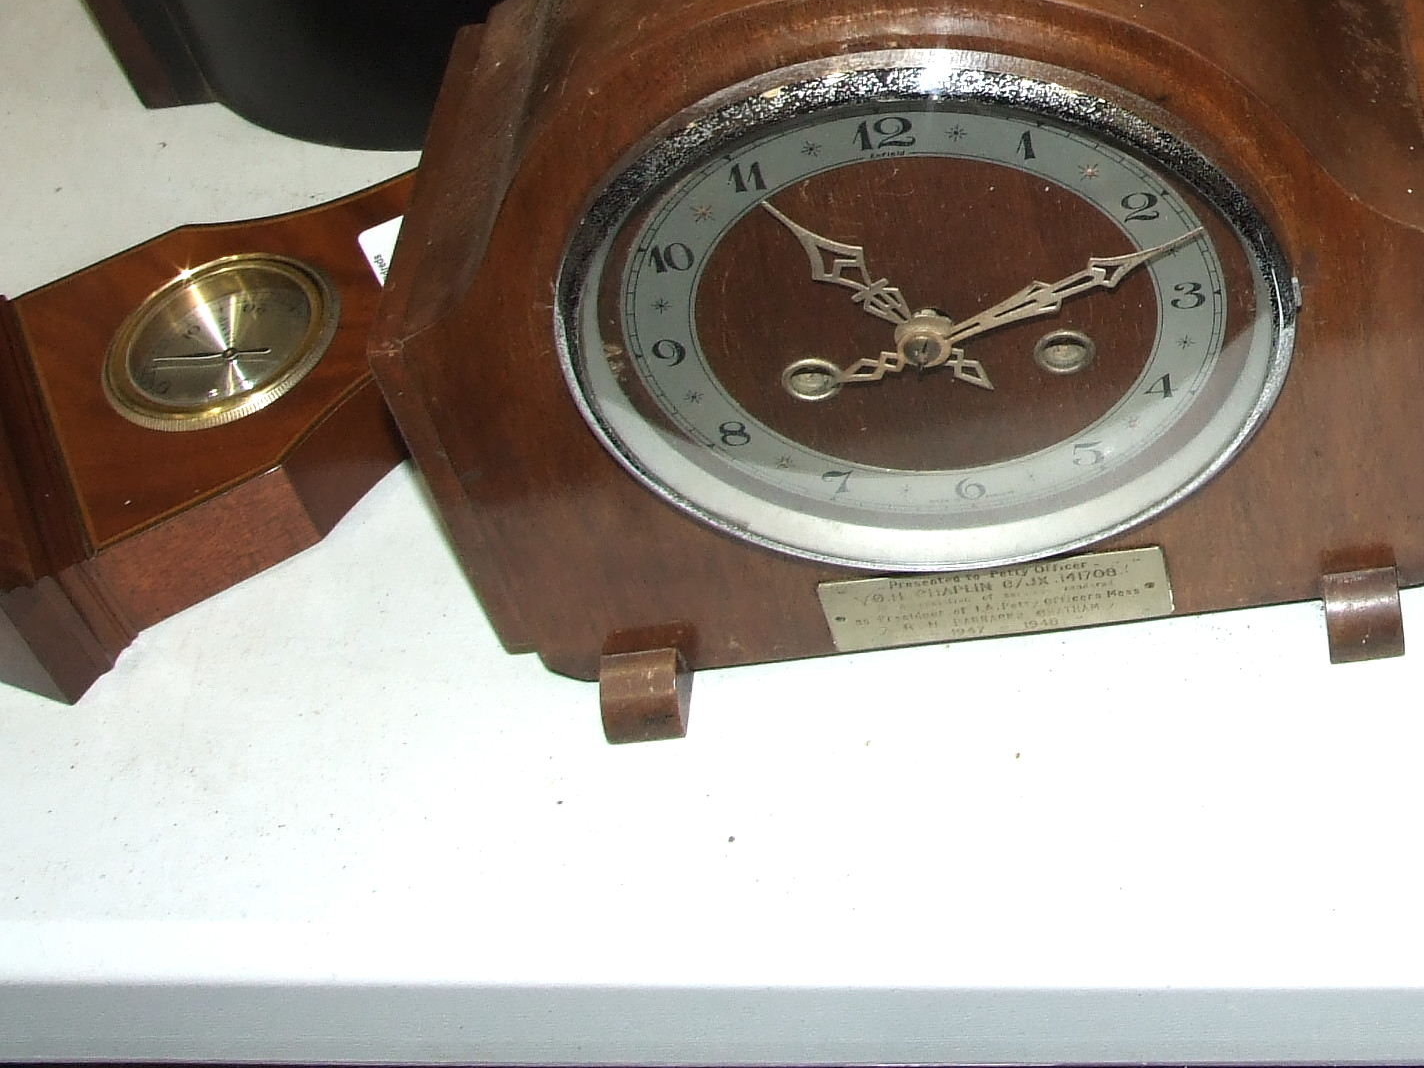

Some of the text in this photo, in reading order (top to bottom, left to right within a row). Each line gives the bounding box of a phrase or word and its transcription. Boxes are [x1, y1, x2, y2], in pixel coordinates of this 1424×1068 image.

[853, 117, 916, 151] 12
[1016, 131, 1036, 160] 1
[728, 161, 768, 193] 11
[1120, 192, 1160, 222] 2
[648, 242, 695, 273] 10
[1170, 283, 1206, 310] 3
[652, 339, 686, 367] 9
[1144, 374, 1178, 398] 4
[719, 421, 751, 446] 8
[1072, 442, 1105, 467] 5
[822, 470, 853, 500] 7
[955, 477, 987, 501] 6
